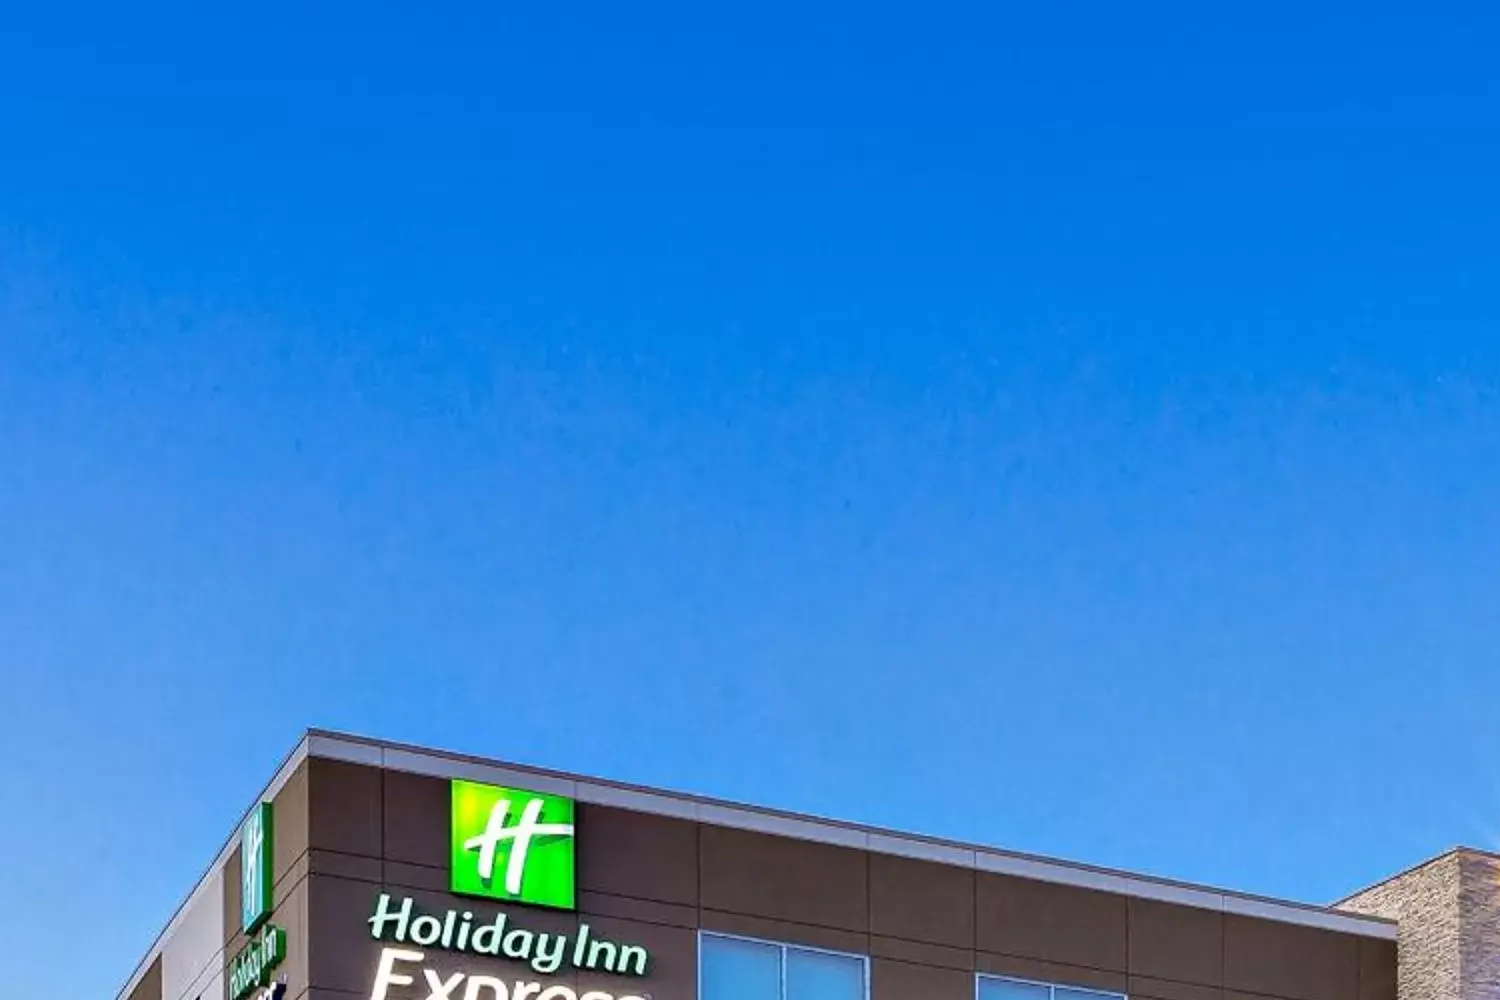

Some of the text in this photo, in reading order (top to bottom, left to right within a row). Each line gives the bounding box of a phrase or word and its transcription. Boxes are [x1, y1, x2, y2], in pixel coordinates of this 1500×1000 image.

[464, 798, 574, 895] H
[368, 893, 649, 976] Holiday Inn
